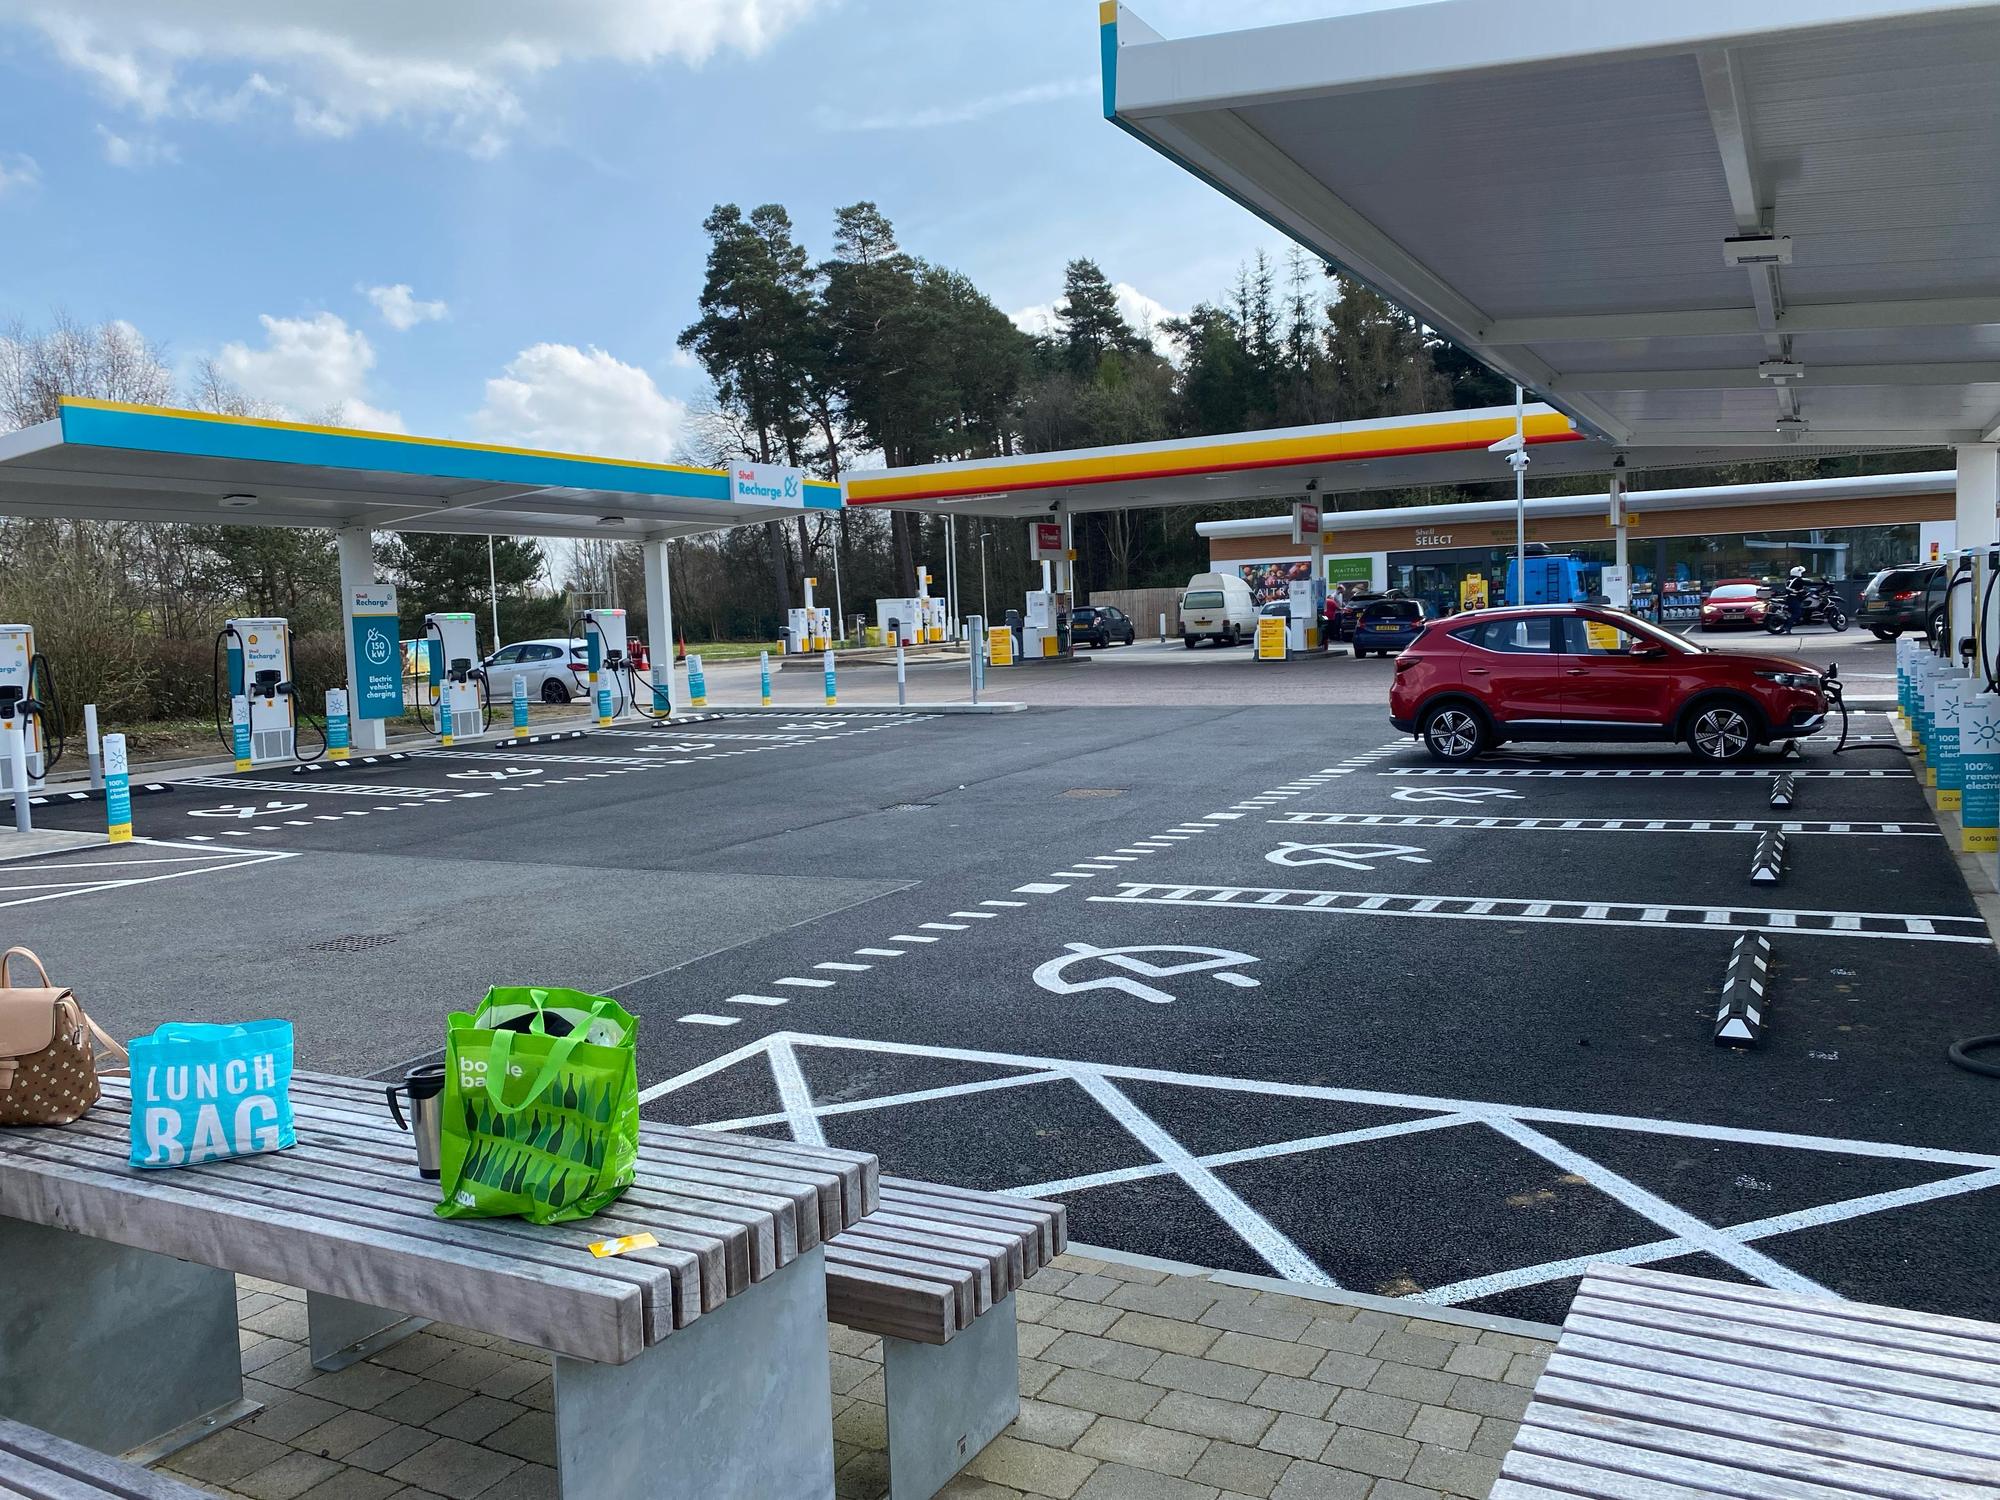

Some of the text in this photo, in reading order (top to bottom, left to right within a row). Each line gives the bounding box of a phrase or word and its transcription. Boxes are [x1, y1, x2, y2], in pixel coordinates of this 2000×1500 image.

[738, 470, 754, 480] Shell
[738, 482, 781, 500] Recharge
[1415, 528, 1435, 536] Shell
[1415, 535, 1453, 546] SELECT
[355, 599, 388, 607] Recharge
[371, 642, 385, 650] 150
[371, 650, 386, 658] kW
[366, 690, 396, 699] charging
[1940, 751, 1960, 759] elect
[1964, 762, 1994, 772] 100%
[1966, 773, 2000, 781] renew
[460, 1056, 523, 1077] bole
[147, 1053, 275, 1102] LUNCH
[460, 1072, 487, 1088] ba
[144, 1094, 280, 1166] BAG
